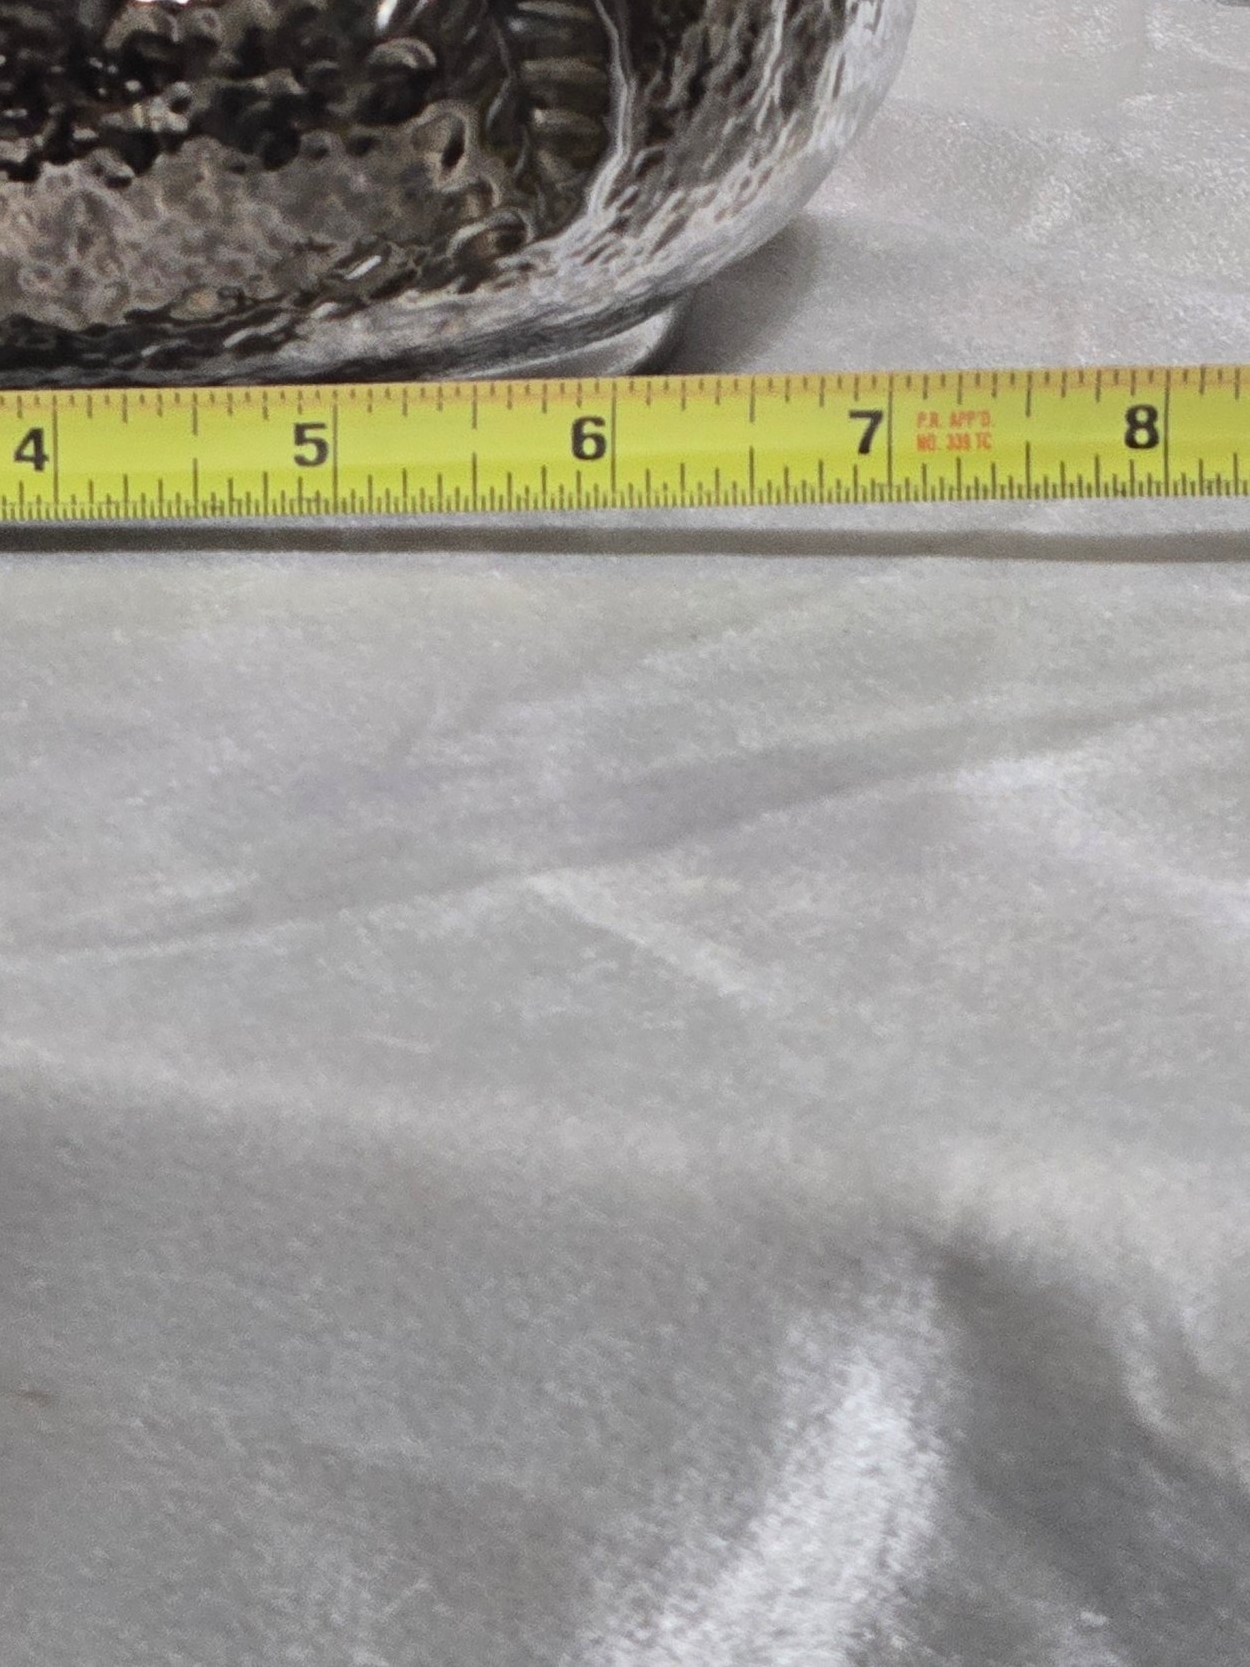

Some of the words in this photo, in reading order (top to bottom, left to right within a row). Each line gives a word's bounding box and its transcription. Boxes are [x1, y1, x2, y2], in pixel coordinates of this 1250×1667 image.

[13, 426, 50, 472] 4
[293, 421, 330, 467] 5
[571, 415, 607, 461] 6
[848, 408, 884, 455] 7
[1124, 403, 1160, 450] 8
